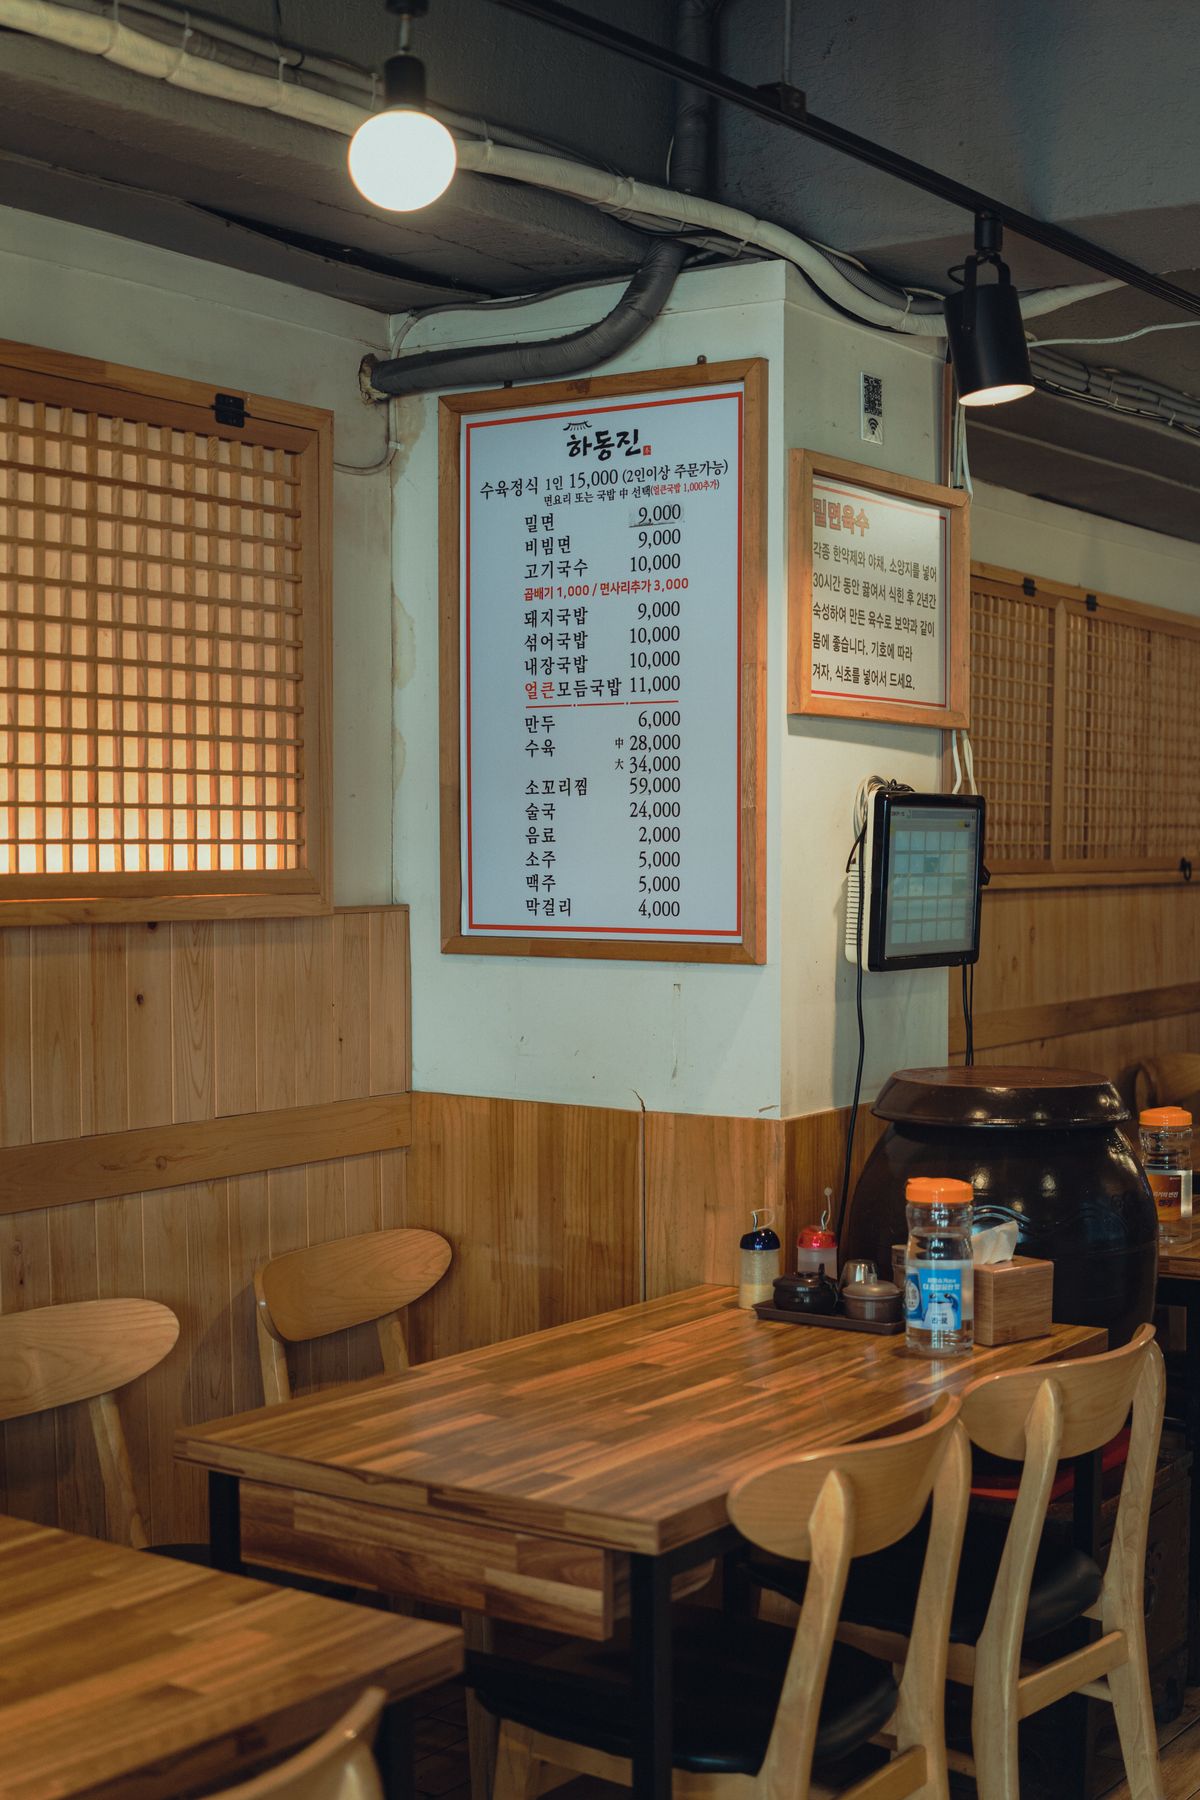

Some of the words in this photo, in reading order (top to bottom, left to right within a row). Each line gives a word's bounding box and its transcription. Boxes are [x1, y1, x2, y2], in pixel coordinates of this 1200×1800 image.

[566, 429, 641, 461] 하동진
[480, 476, 538, 500] 수육정식
[546, 475, 563, 491] 1인
[570, 469, 618, 489] 15,000
[622, 465, 671, 484] (2인이상
[674, 459, 728, 479] 주문가능)
[544, 492, 571, 507] 면요리
[574, 491, 594, 503] 또는
[596, 488, 616, 502] 국밥
[619, 488, 628, 499] 中
[525, 513, 554, 533] 밀면
[637, 503, 682, 525] 9,000
[812, 497, 870, 537] 밀면육수
[525, 535, 571, 557] 비빔면
[638, 528, 681, 549] 9,000
[524, 558, 588, 579] 고기국수
[631, 553, 681, 573] 10,000
[813, 541, 830, 561] 각종
[833, 545, 866, 568] 한약제와
[868, 554, 887, 573] 야채,
[889, 558, 920, 579] 소양지를
[922, 565, 937, 583] 넣어
[524, 586, 553, 601] 곱배기
[557, 585, 589, 599] 1,000
[600, 579, 651, 596] 면사리추가
[654, 578, 688, 592] 3,000
[812, 571, 841, 592] 30시간
[843, 577, 860, 596] 동안
[862, 581, 886, 601] 끓여서
[906, 589, 915, 606] 후
[916, 592, 936, 610] 2년간
[524, 606, 588, 628] 돼지국밥
[638, 601, 680, 621] 9,000
[812, 602, 846, 623] 숙성하여
[849, 608, 866, 626] 만든
[868, 611, 892, 629] 육수로
[894, 616, 918, 635] 보약과
[920, 620, 935, 637] 같이
[524, 630, 588, 652] 섞어국밥
[630, 625, 680, 645] 10,000
[812, 632, 829, 650] 몸에
[832, 635, 868, 655] 좋습니다.
[871, 641, 895, 659] 기호에
[897, 645, 913, 662] 따라
[524, 655, 588, 676] 내장국밥
[630, 650, 680, 670] 10,000
[812, 662, 832, 681] 겨자,
[835, 665, 860, 684] 식초를
[863, 669, 887, 687] 넣어서
[889, 673, 915, 690] 드세요.
[525, 677, 622, 700] 얼큰모듬국밥
[630, 675, 680, 694] 11,000
[525, 715, 555, 733] 만두
[638, 710, 680, 729] 6,000
[525, 739, 556, 758] 수육
[615, 737, 624, 749] 中
[630, 734, 681, 753] 28,000
[615, 758, 624, 770] 大
[629, 754, 681, 774] 34,000
[525, 777, 587, 796] 소꼬리찜
[630, 777, 680, 795] 59,000
[525, 802, 556, 821] 술국
[630, 800, 681, 820] 24,000
[525, 826, 556, 845] 음료
[639, 826, 680, 845] 2,000
[525, 851, 556, 869] 소주
[639, 851, 680, 869] 5,000
[526, 874, 556, 893] 맥주
[639, 875, 680, 894] 5,000
[526, 897, 571, 917] 막걸리
[638, 899, 680, 919] 4,000
